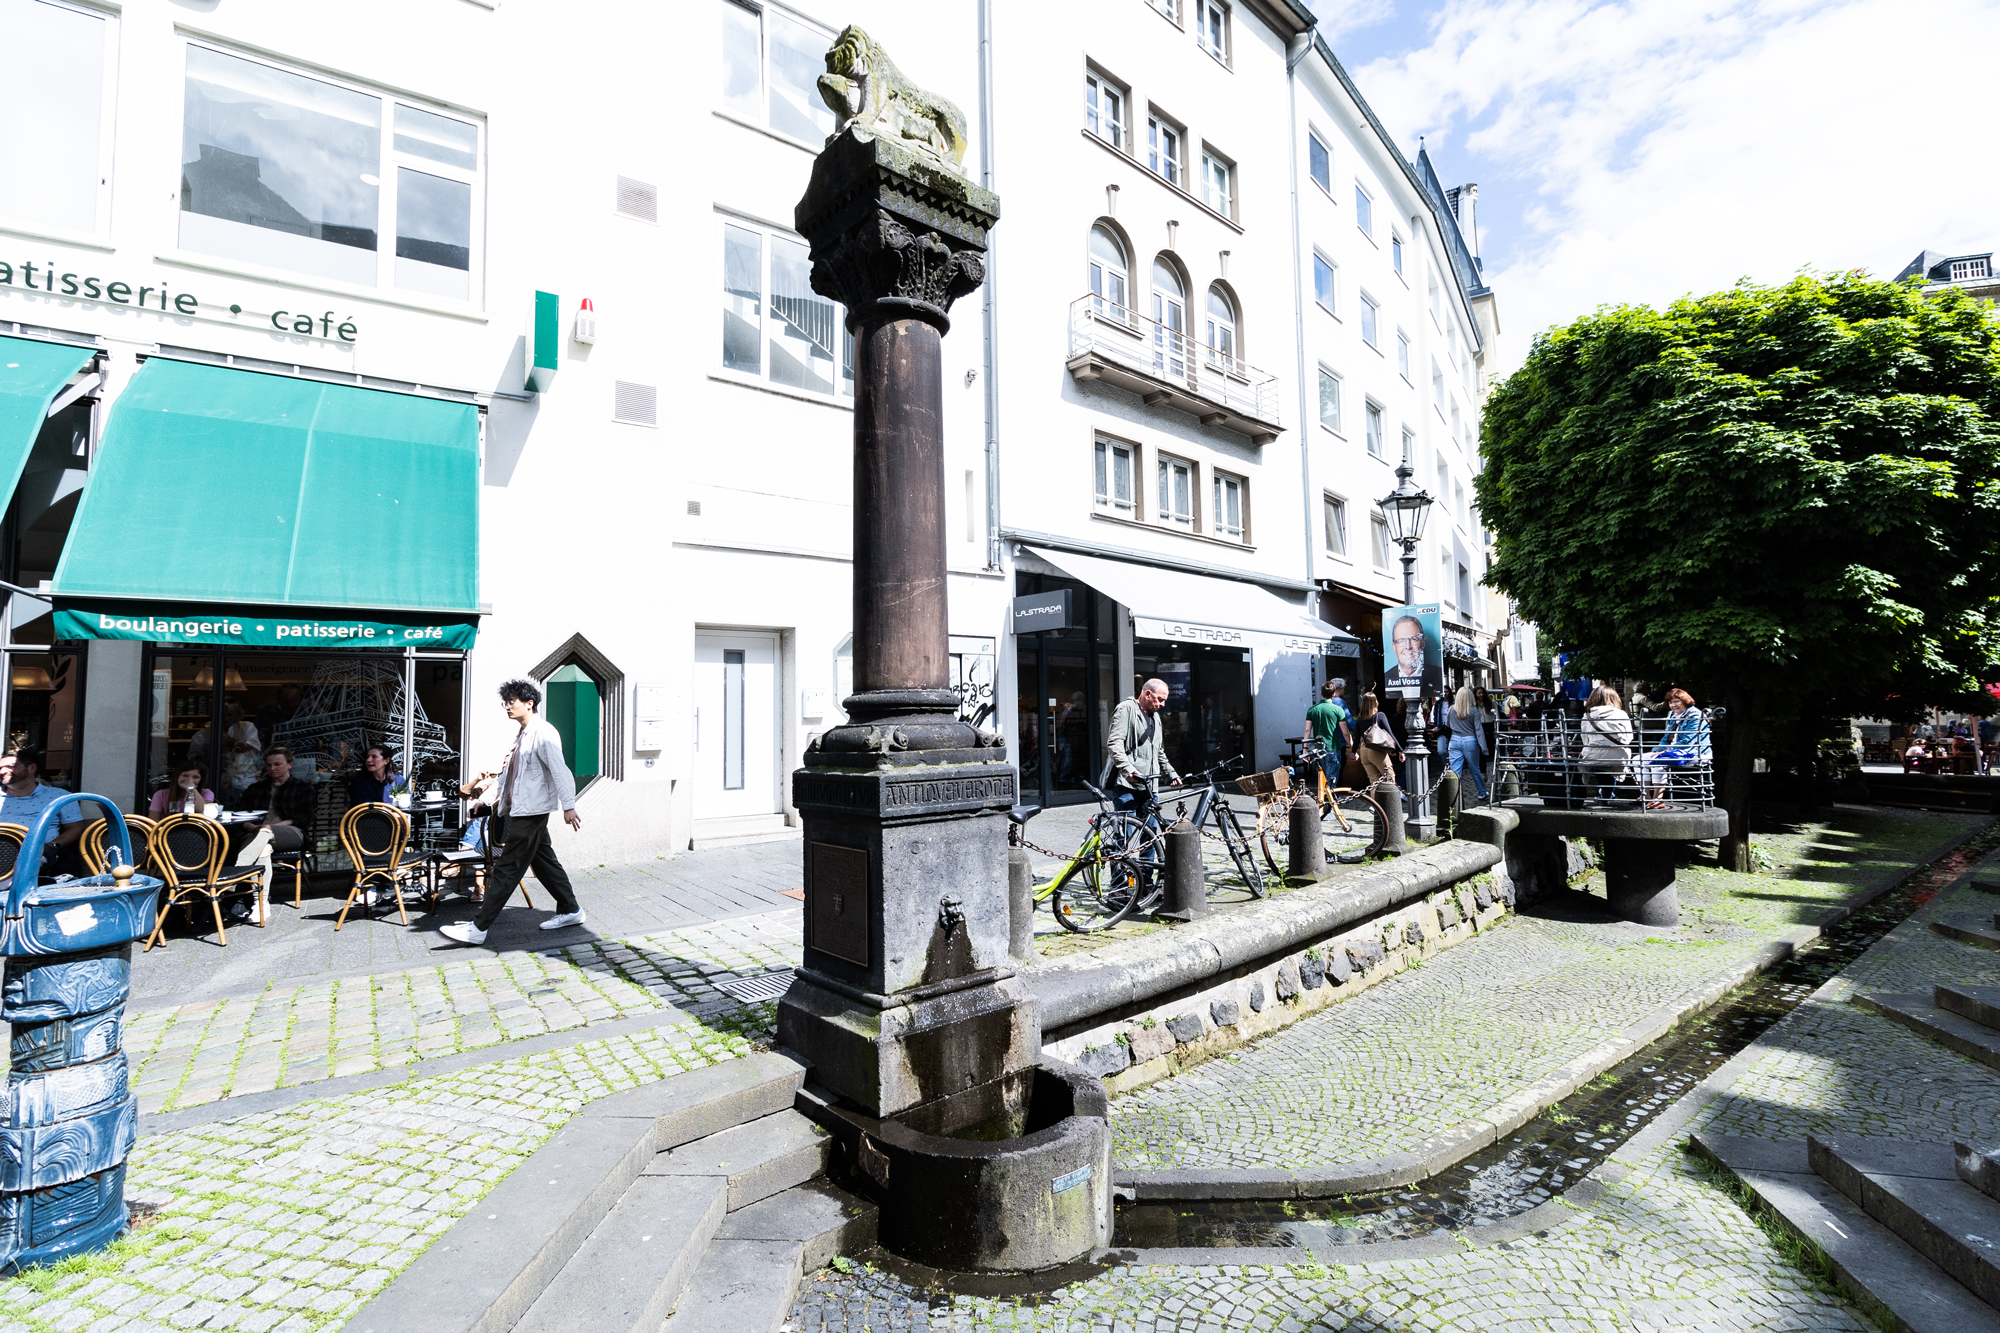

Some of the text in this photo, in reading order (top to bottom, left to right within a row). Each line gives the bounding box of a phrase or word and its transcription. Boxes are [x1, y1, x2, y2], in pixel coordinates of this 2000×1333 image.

[270, 310, 358, 342] café
[99, 614, 443, 640] boulangerie patisserie café
